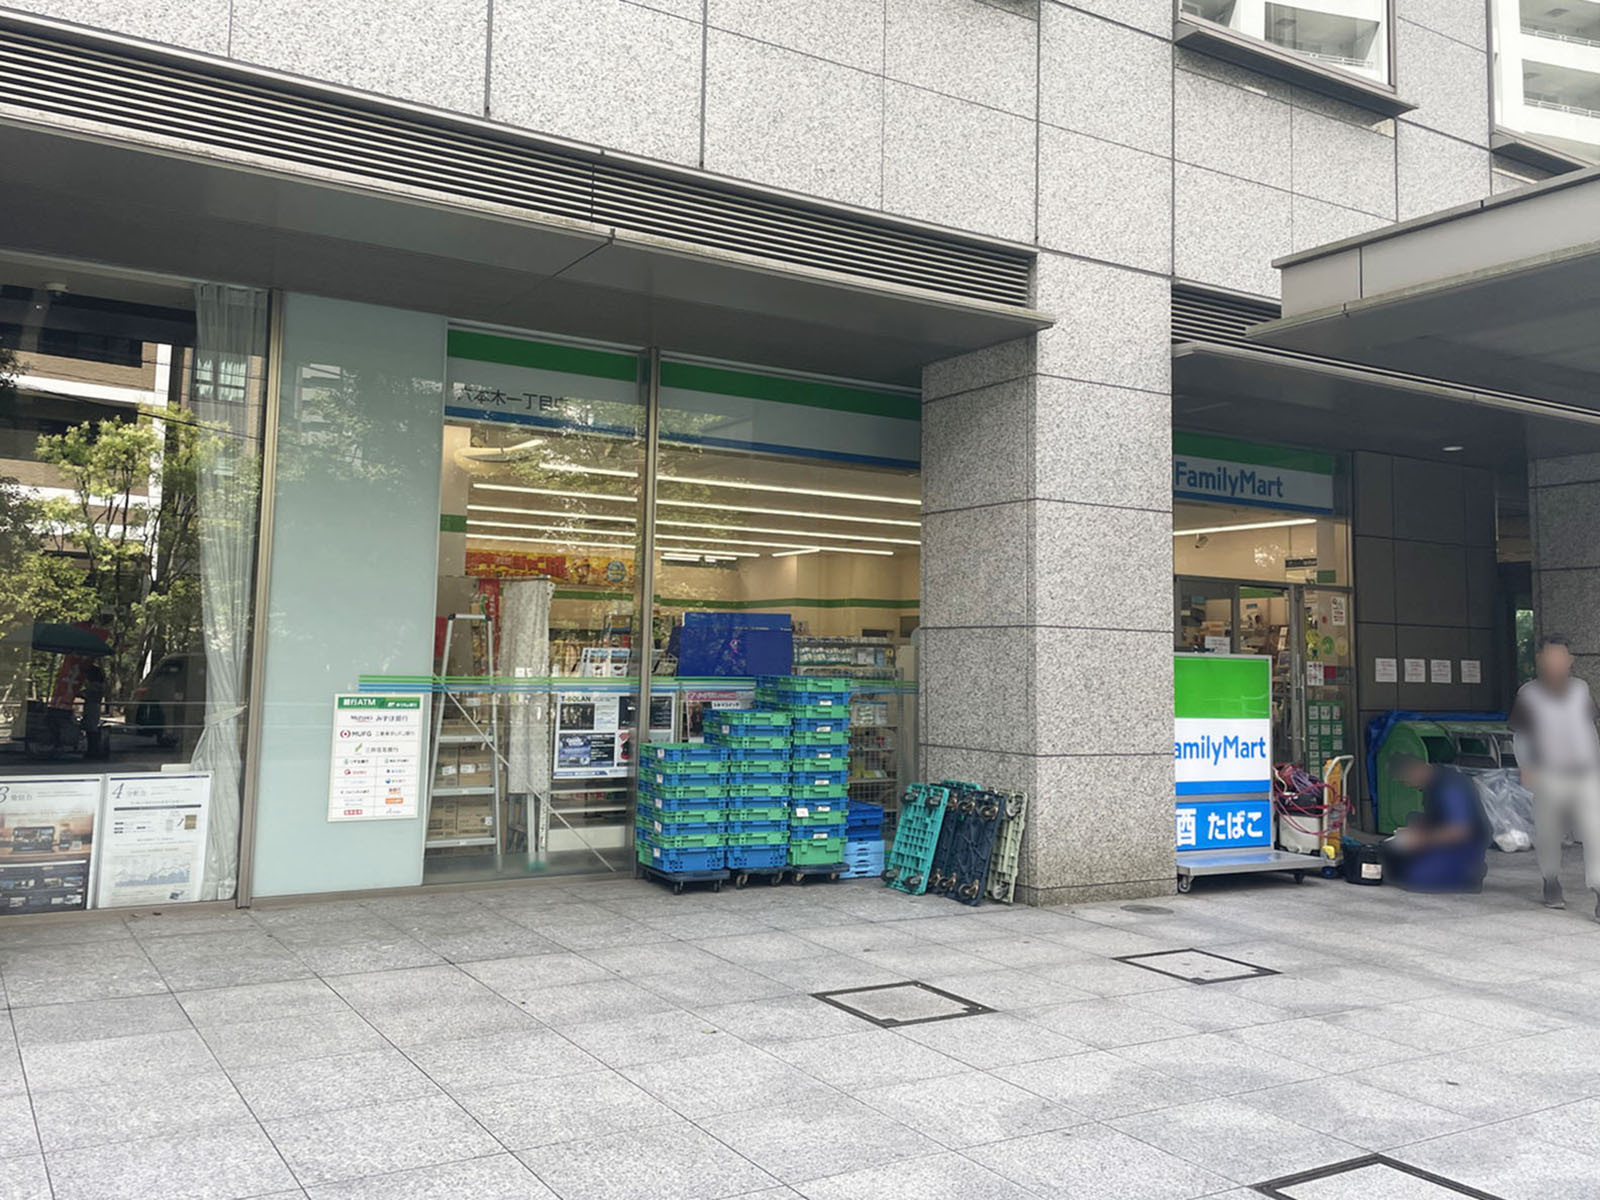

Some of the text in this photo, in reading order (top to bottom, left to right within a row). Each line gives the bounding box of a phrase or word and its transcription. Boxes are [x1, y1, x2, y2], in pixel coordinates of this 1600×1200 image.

[1175, 461, 1284, 498] FamilyMart
[1174, 735, 1266, 766] amilyMart
[1207, 810, 1264, 840] たばこ
